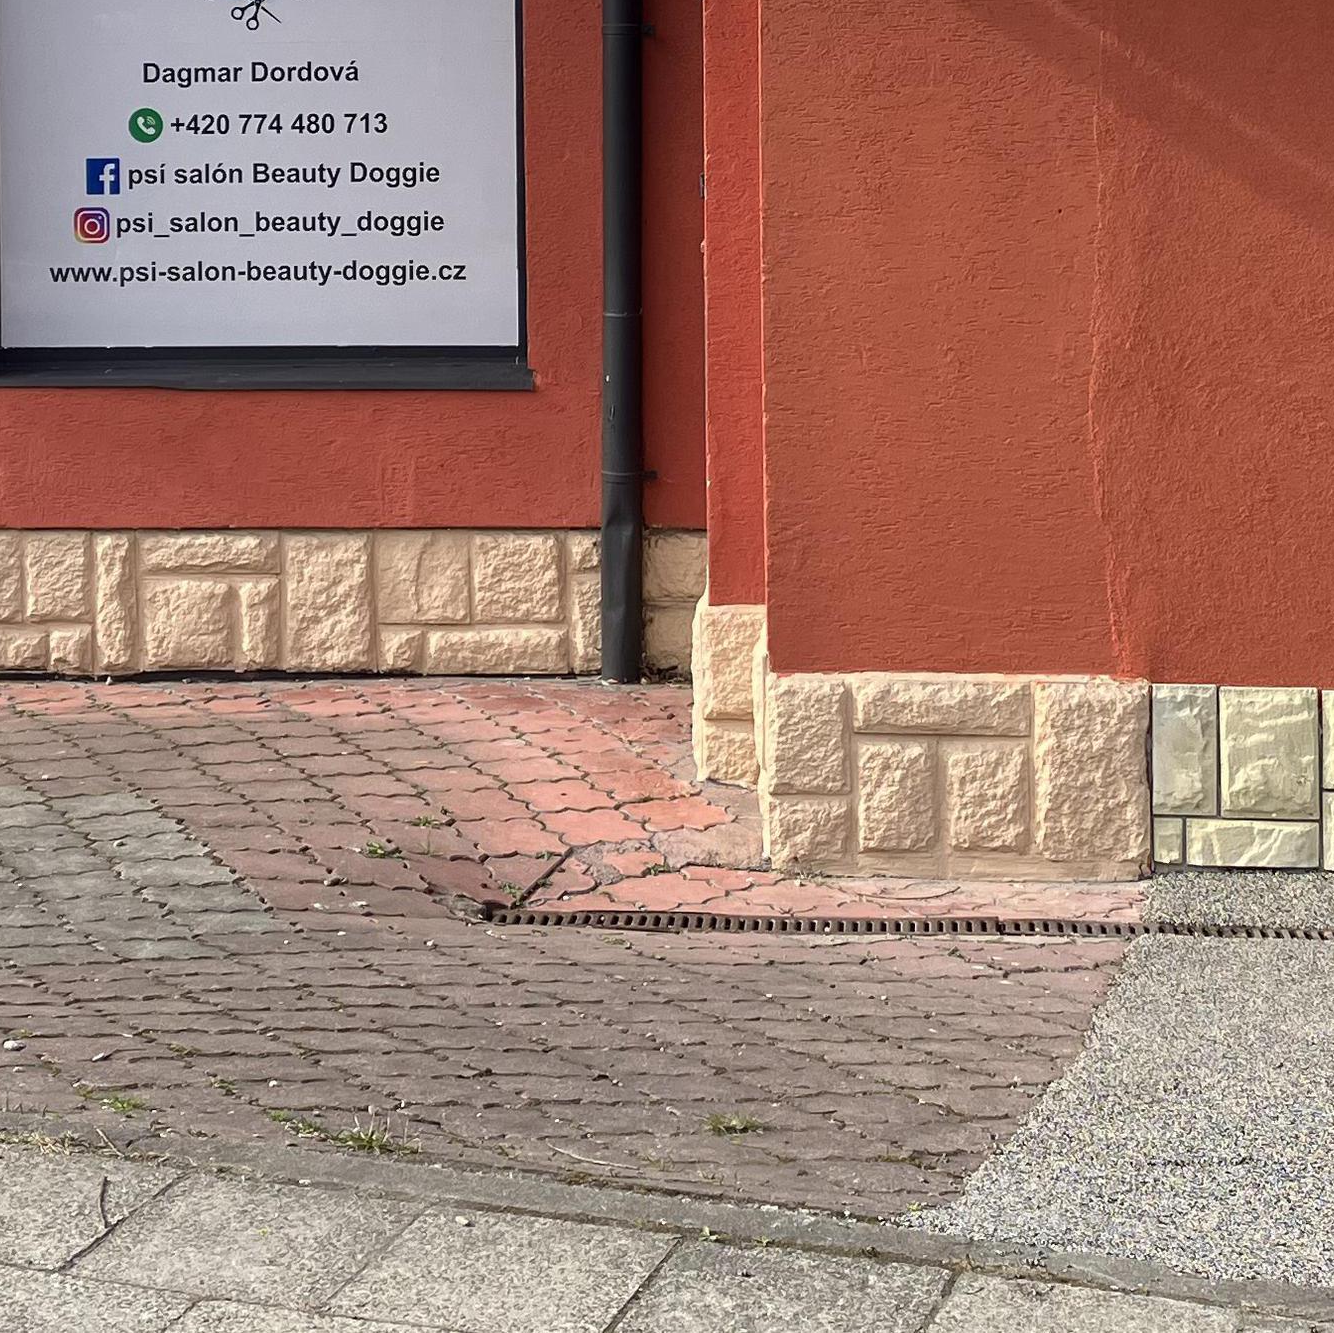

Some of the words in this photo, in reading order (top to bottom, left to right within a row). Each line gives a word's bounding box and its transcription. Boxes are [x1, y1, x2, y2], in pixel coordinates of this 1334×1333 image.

[143, 62, 243, 88] Dagmar
[251, 59, 359, 82] Dordová
[170, 113, 230, 136] +420
[239, 113, 283, 135] 774
[291, 112, 335, 135] 480
[343, 112, 388, 134] 713
[128, 162, 166, 189] psí
[174, 162, 243, 184] salón
[252, 162, 341, 188] Beauty
[351, 161, 441, 187] Doggie
[116, 210, 445, 238] psi_salon_beauty_doggie
[49, 260, 467, 287] www.psi-salon-beauty-doggie.cz
